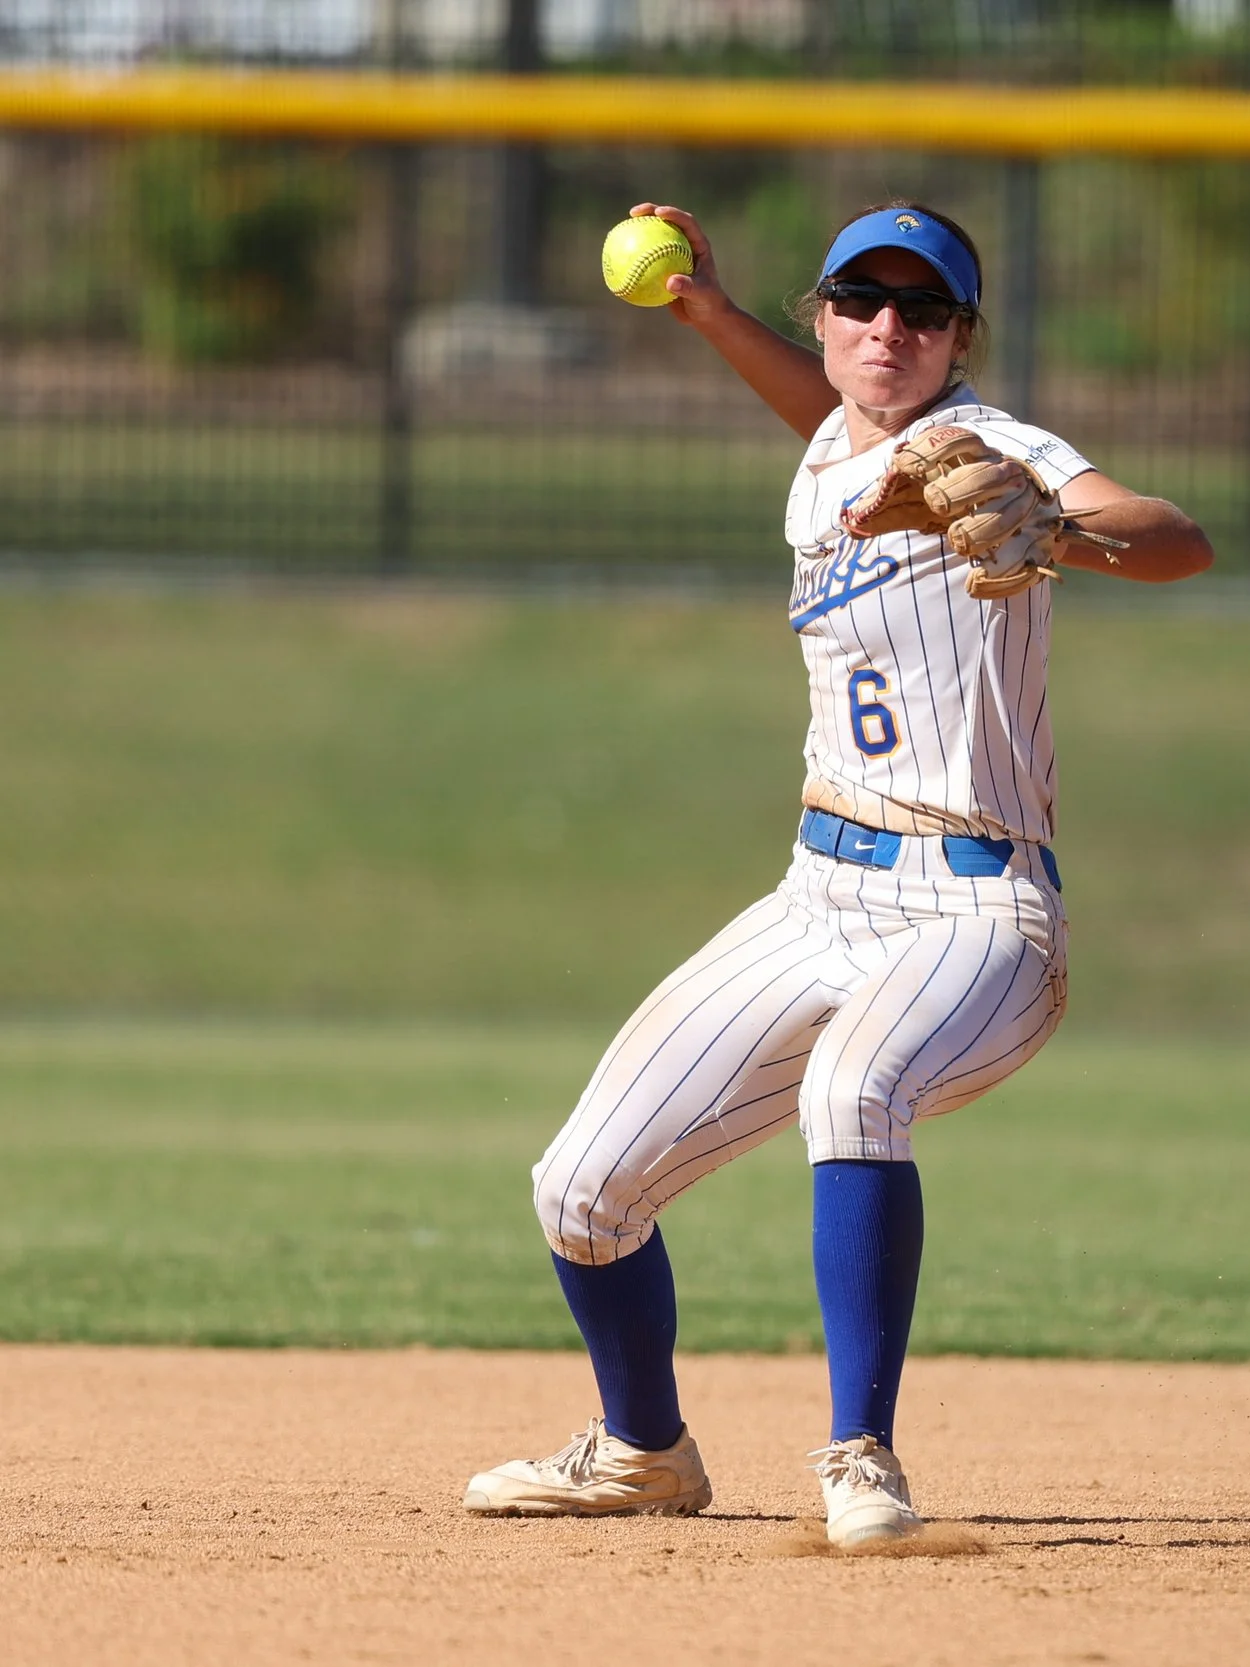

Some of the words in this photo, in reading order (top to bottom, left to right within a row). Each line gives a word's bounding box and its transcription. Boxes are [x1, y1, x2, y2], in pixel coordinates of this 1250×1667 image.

[1024, 451, 1042, 465] AL
[1035, 440, 1057, 455] PAC
[848, 666, 903, 760] 6
